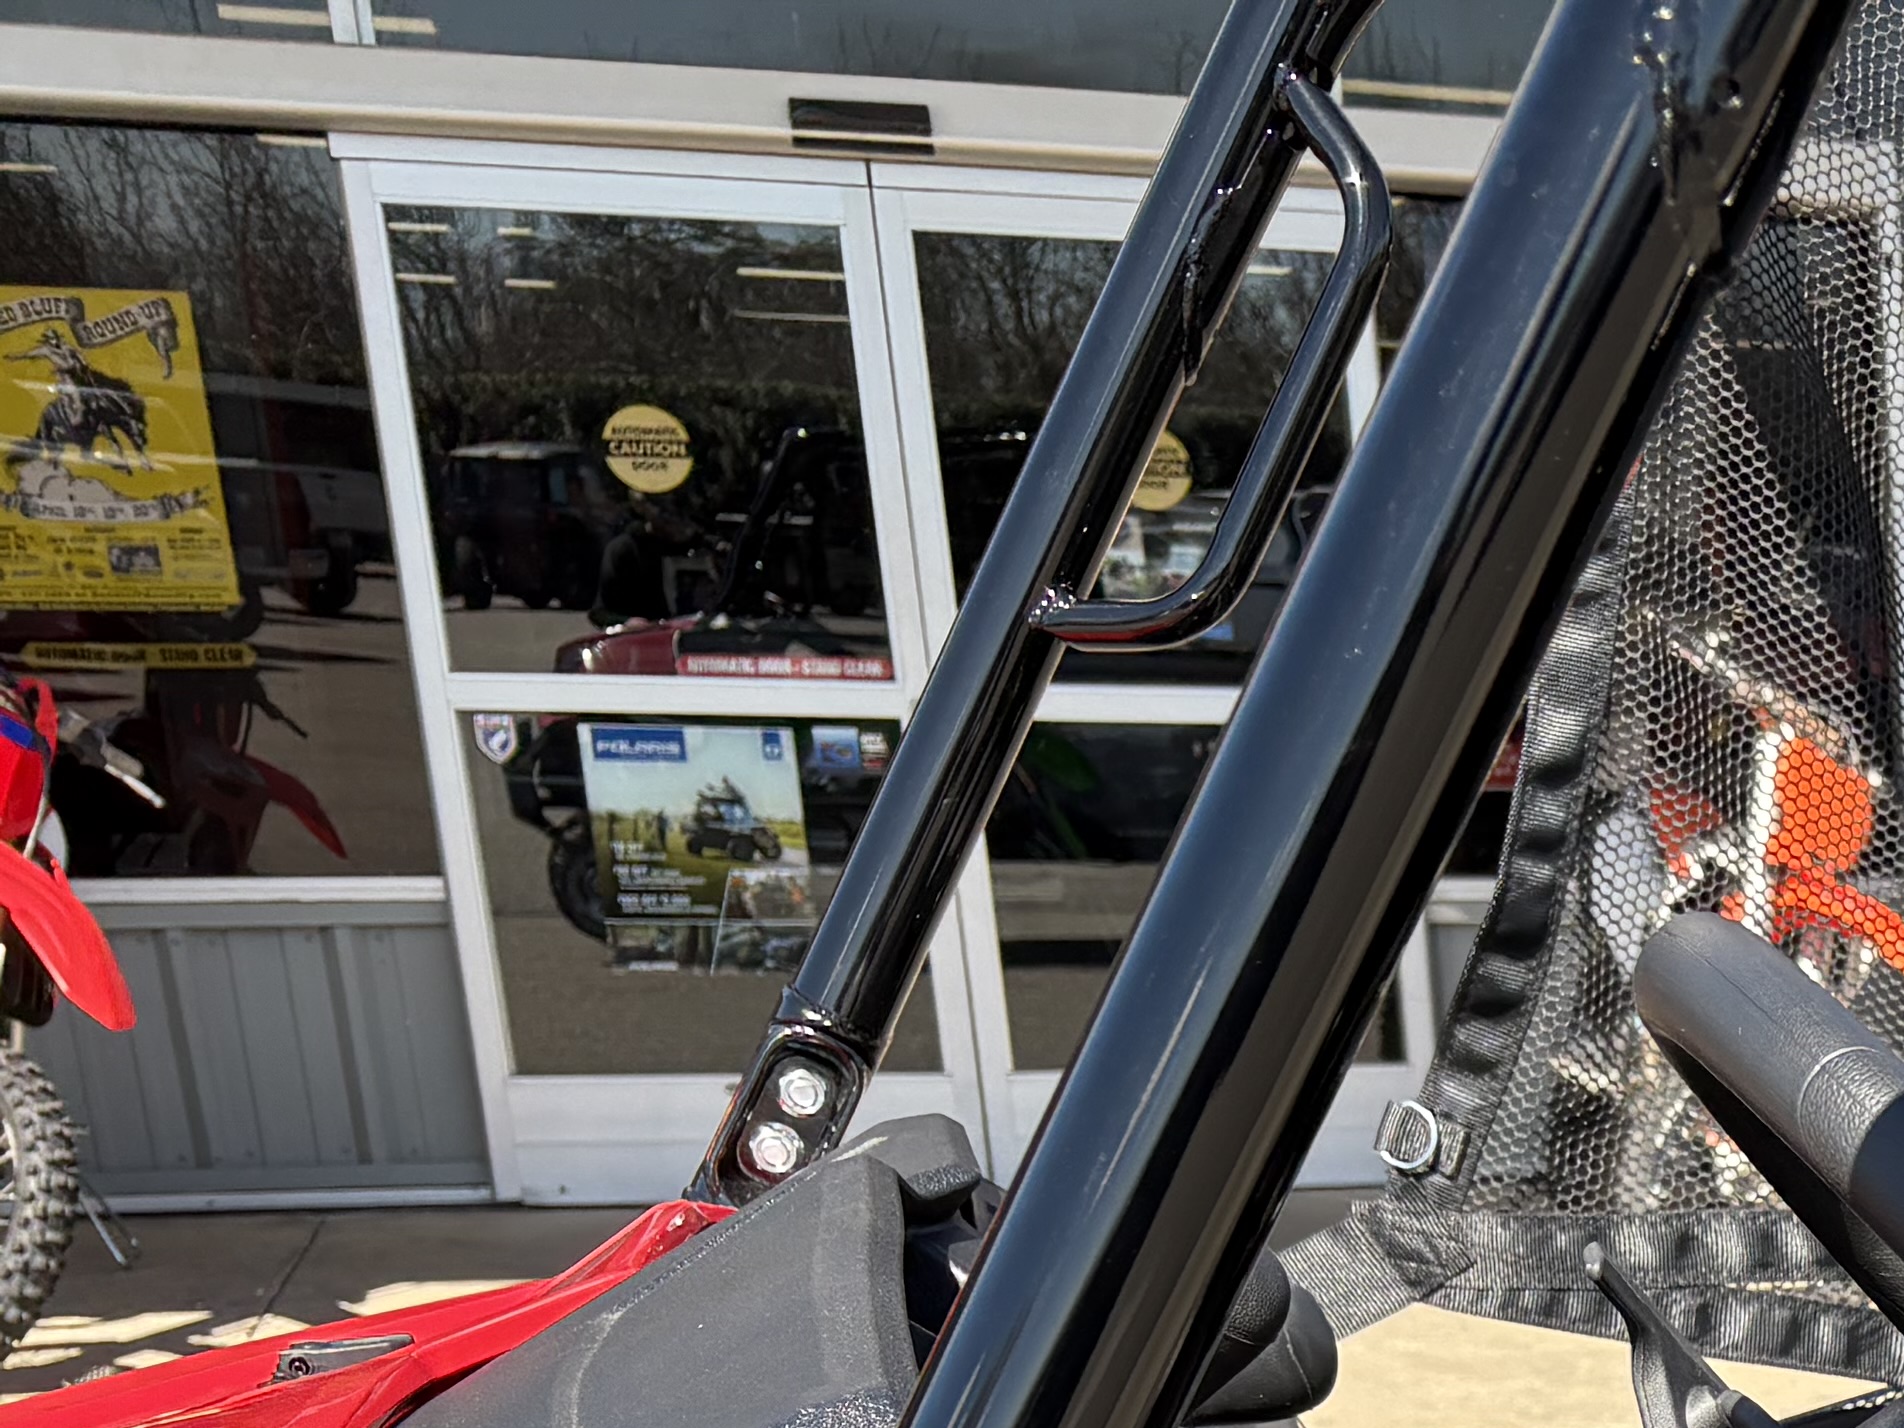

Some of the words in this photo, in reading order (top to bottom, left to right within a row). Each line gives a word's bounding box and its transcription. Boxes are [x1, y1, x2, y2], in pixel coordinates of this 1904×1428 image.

[608, 440, 687, 457] CAUTION
[632, 460, 669, 472] DOOR
[35, 646, 107, 661] AUTOMATIC
[159, 647, 198, 663] STAND
[204, 648, 243, 664] CLEAR
[596, 739, 681, 756] POLARIS
